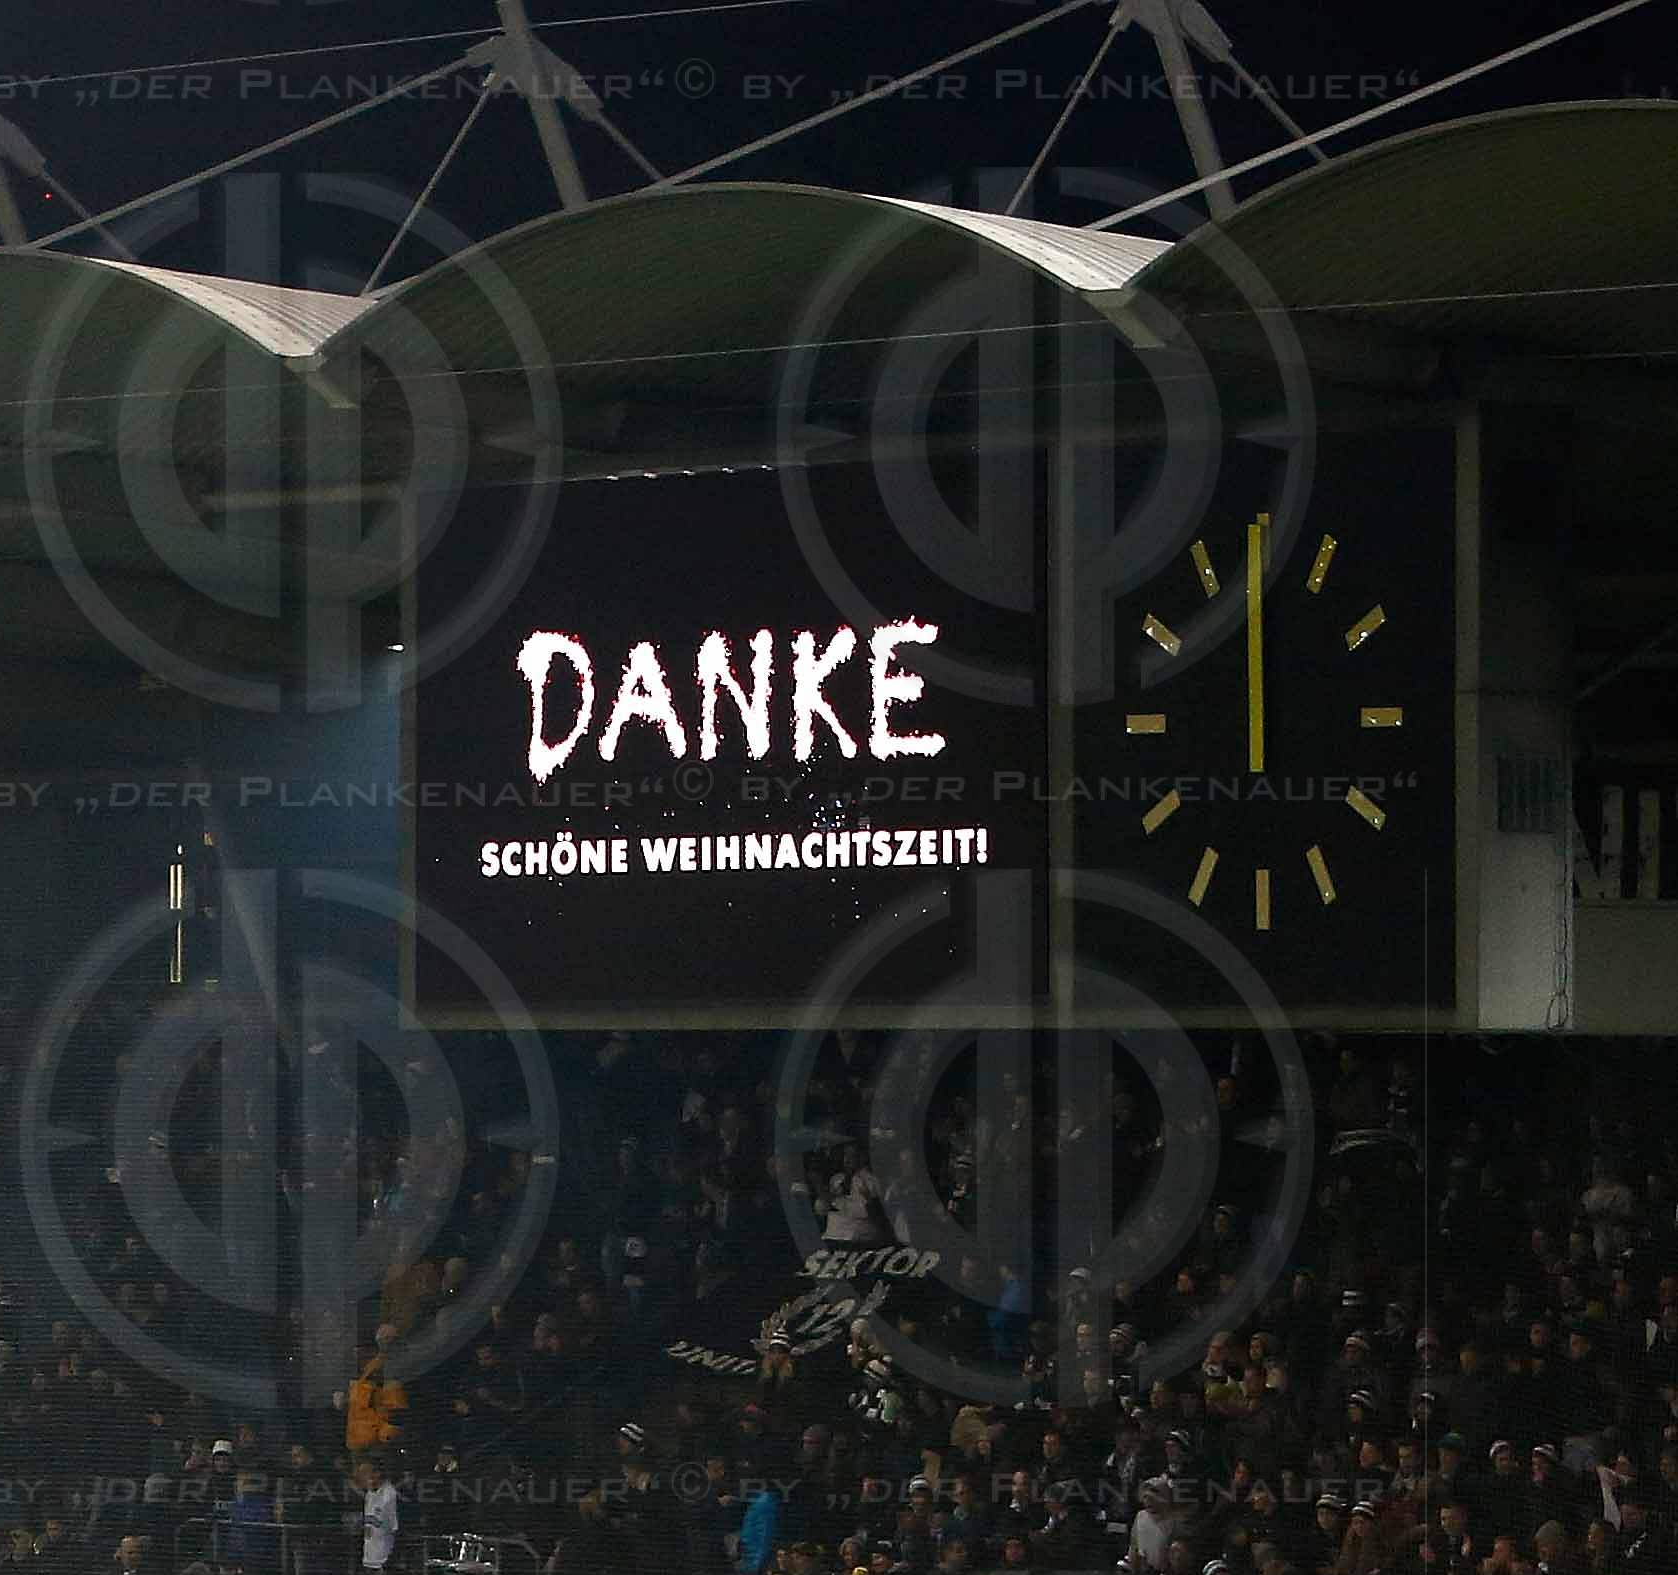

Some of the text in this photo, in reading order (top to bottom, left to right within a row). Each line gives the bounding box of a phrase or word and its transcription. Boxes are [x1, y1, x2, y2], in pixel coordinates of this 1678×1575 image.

[516, 616, 946, 786] DANKE
[480, 826, 990, 878] SCHÖNE WEIHNACHTSZEIT!
